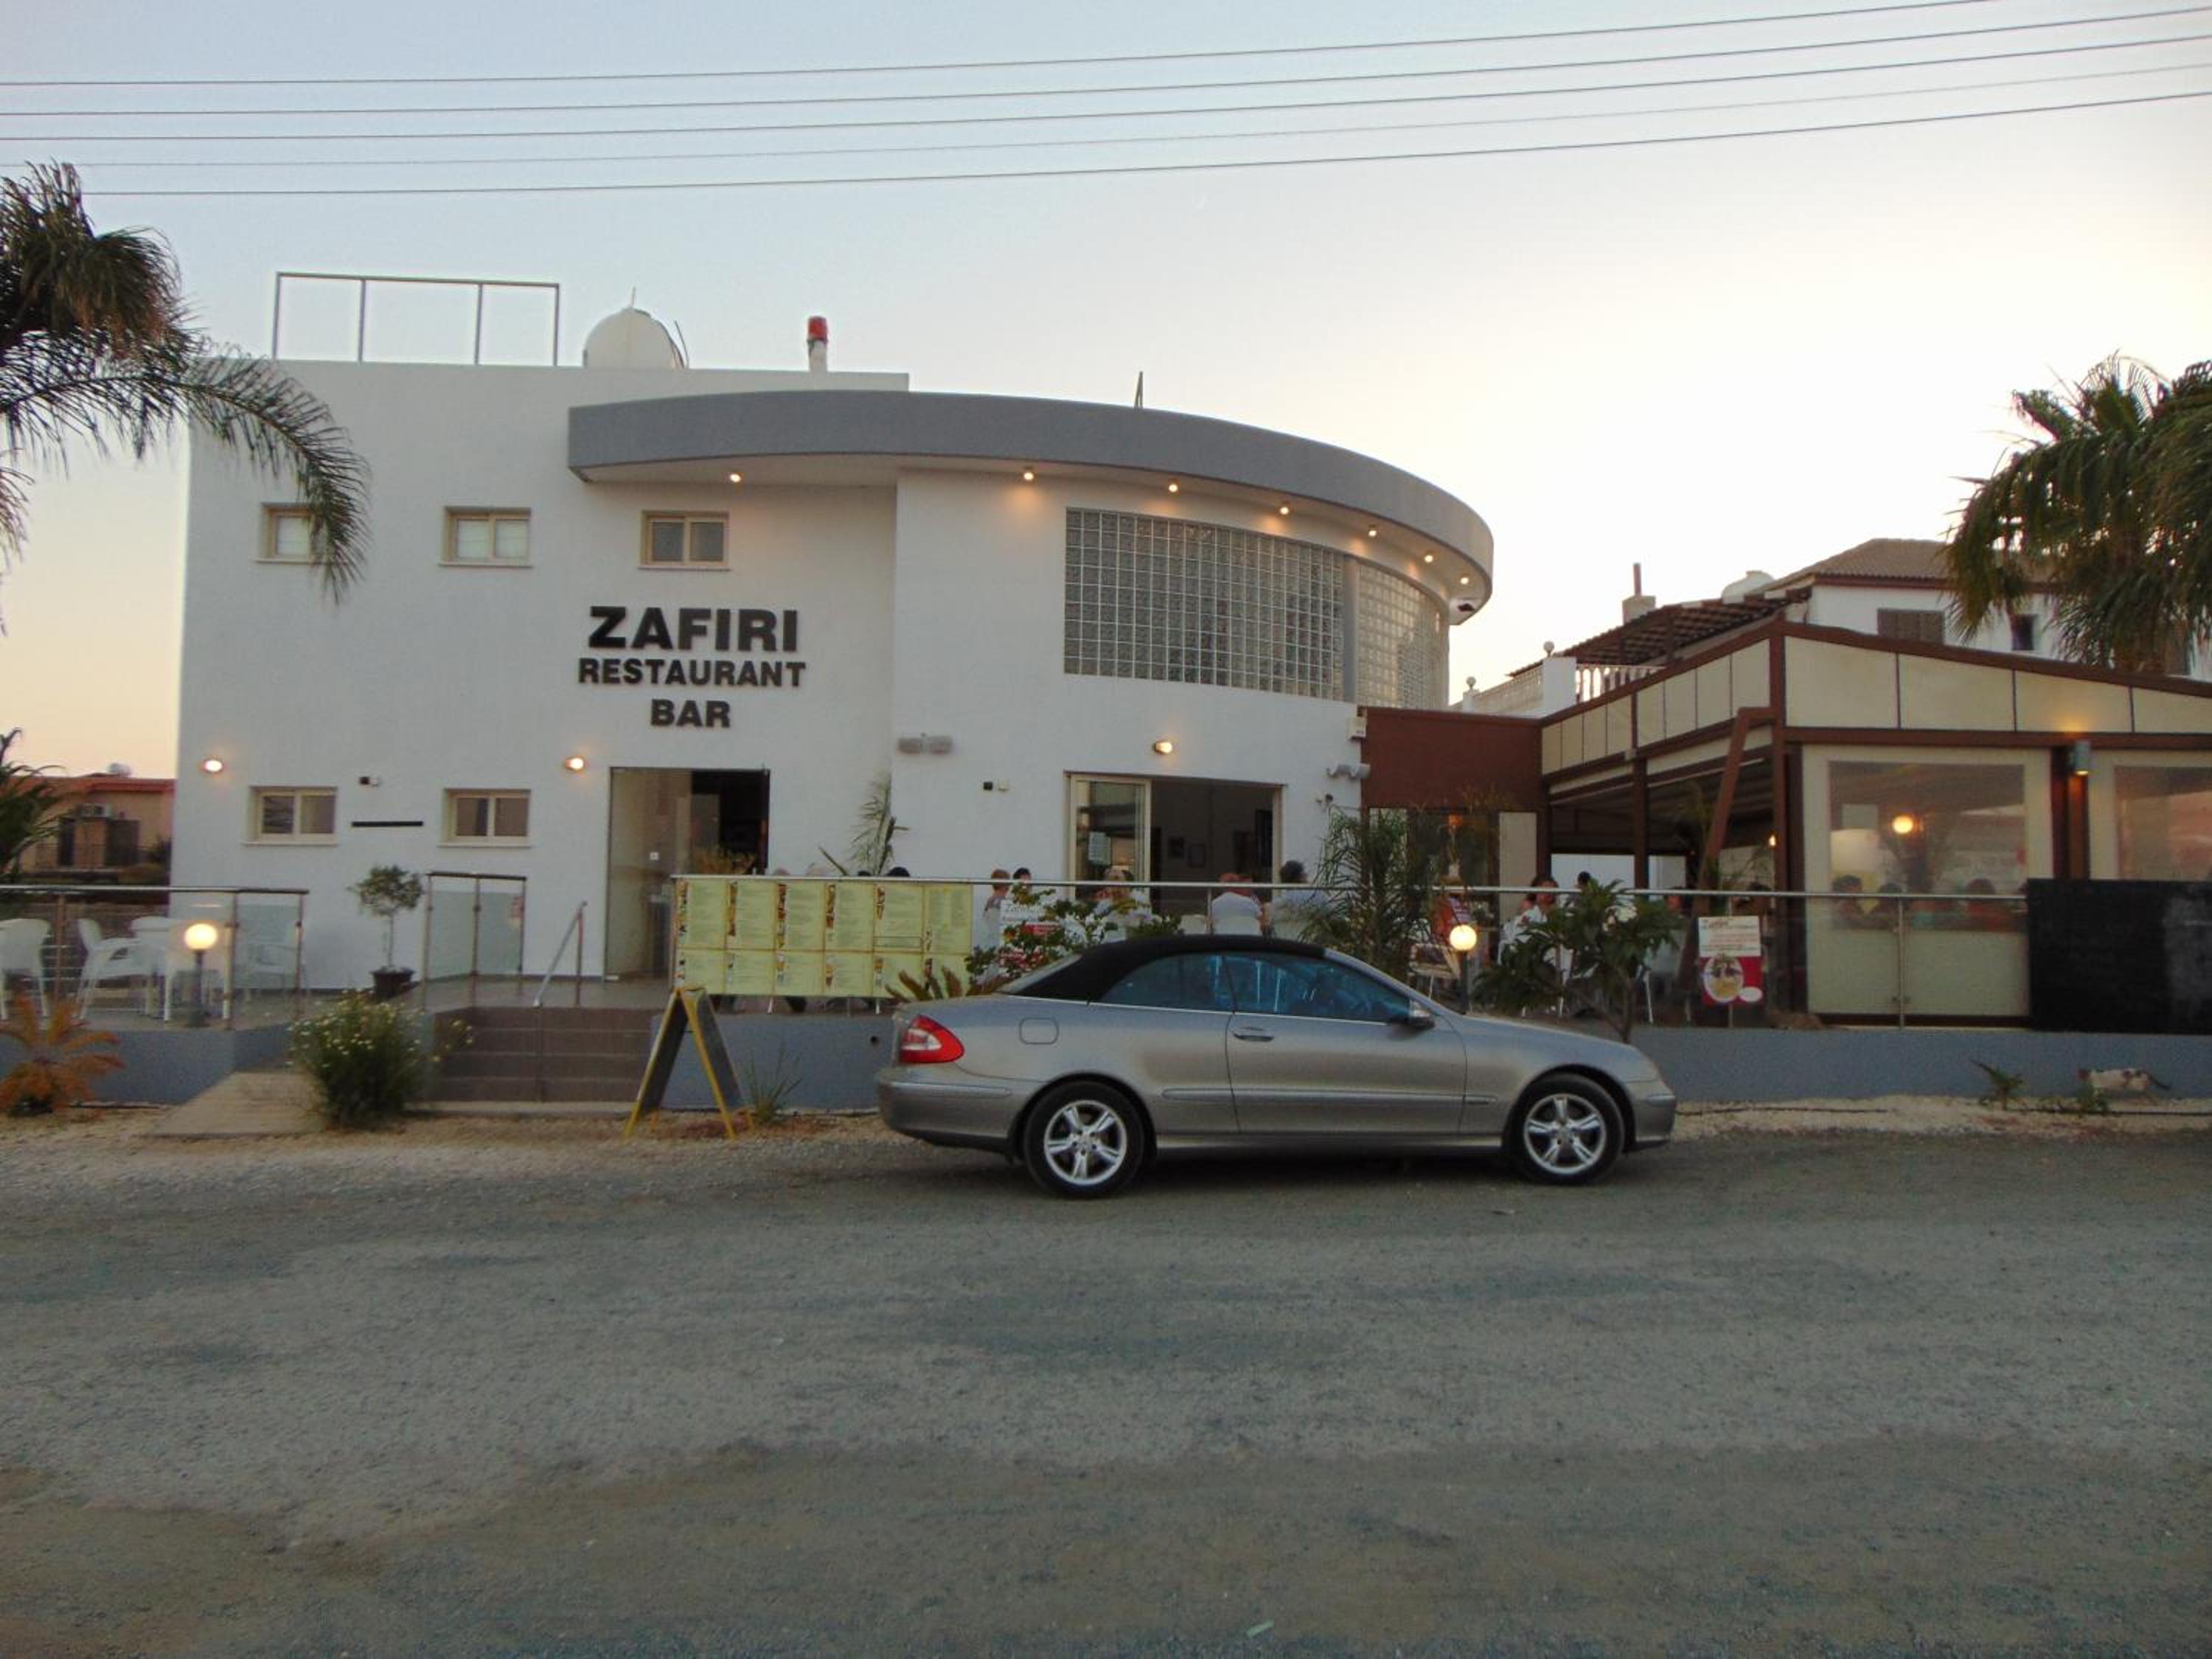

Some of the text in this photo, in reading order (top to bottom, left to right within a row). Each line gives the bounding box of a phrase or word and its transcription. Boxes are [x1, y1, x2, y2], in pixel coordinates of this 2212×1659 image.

[588, 606, 798, 652] ZAFIRI
[578, 658, 806, 687] RESTAURANT
[650, 698, 731, 728] BAR
